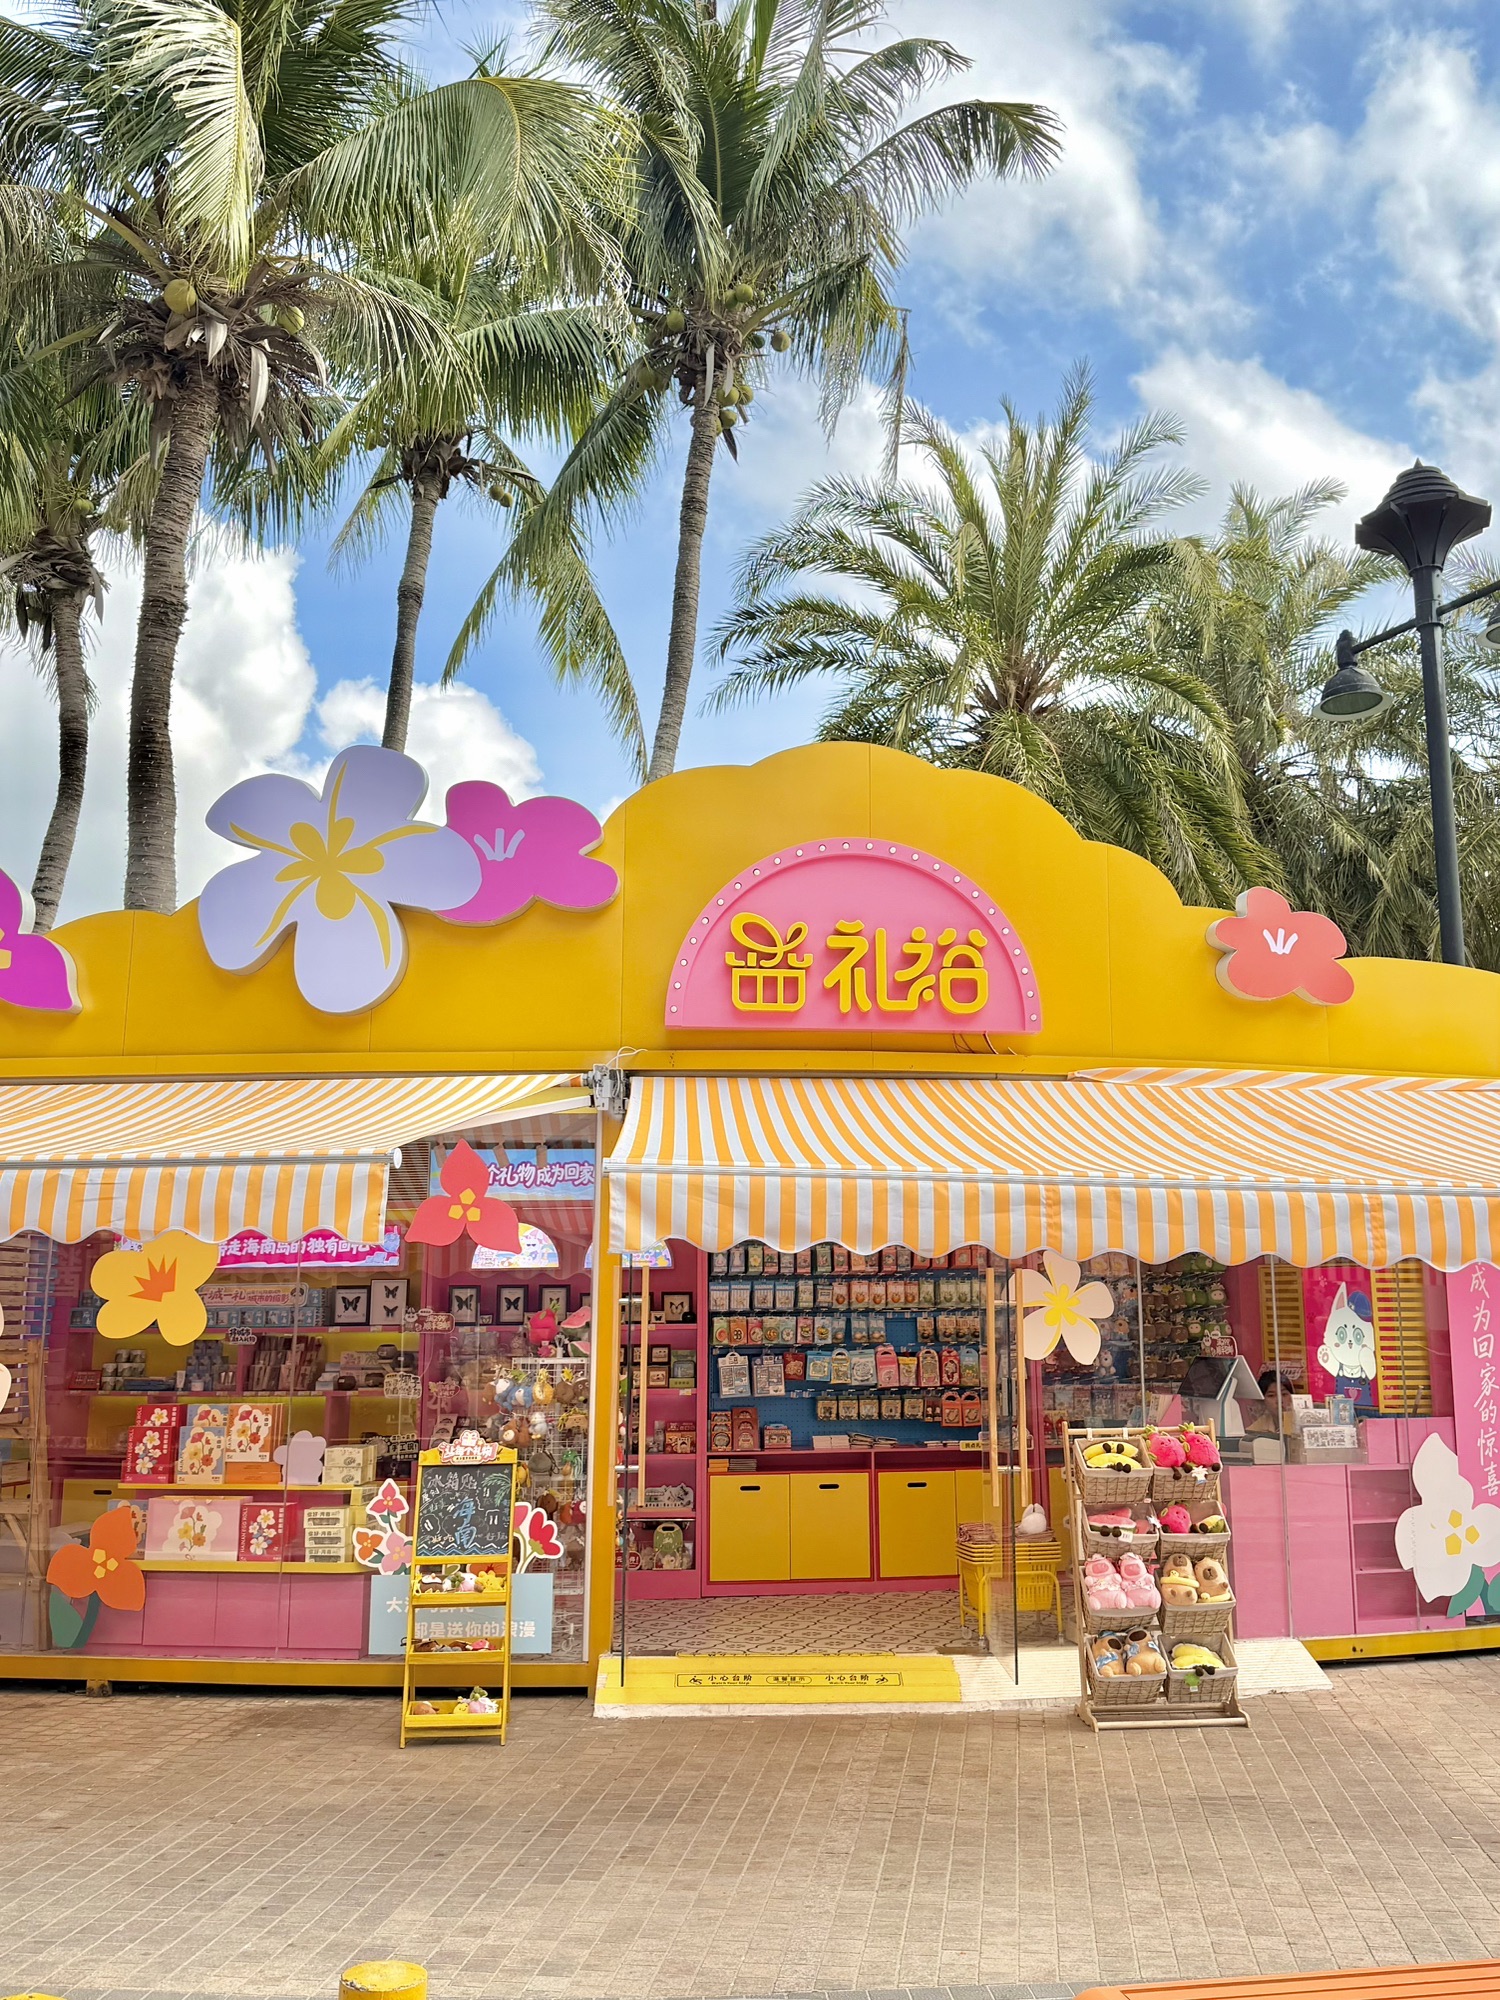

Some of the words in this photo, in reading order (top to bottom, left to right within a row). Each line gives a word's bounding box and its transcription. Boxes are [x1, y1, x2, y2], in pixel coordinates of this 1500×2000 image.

[487, 1162, 595, 1188] 个礼物成为回家
[1470, 1264, 1500, 1497] 成为回家的惊喜
[427, 1472, 477, 1490] 冰箱贴
[453, 1496, 477, 1549] 海南
[414, 1621, 536, 1638] 都是送你的浪漫
